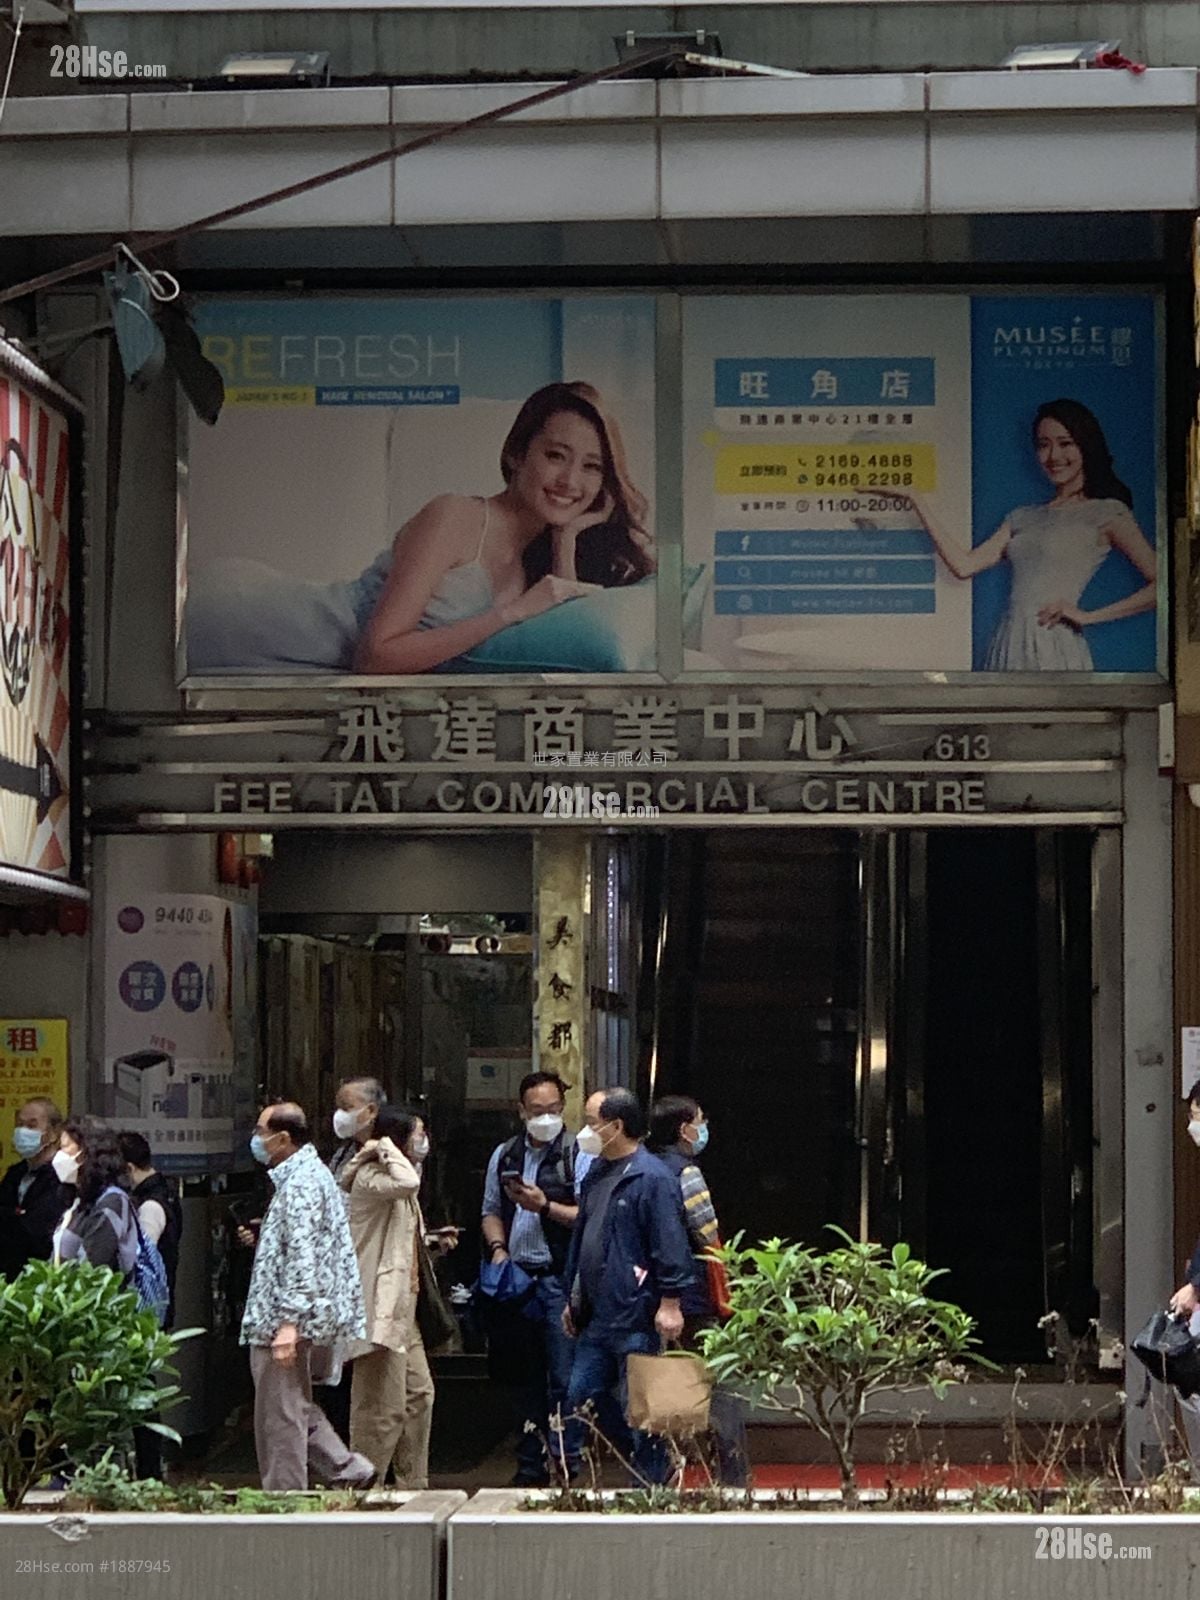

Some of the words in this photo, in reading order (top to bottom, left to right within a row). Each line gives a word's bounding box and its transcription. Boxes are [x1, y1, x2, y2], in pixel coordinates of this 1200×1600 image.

[740, 369, 912, 400] 旺角店
[337, 693, 859, 764] 飛達商業中心
[935, 733, 990, 761] 613
[213, 780, 292, 813] FEE
[329, 780, 408, 813] TAT
[801, 778, 985, 813] CENTRE
[155, 906, 194, 923] 9440
[7, 1027, 38, 1052] 租
